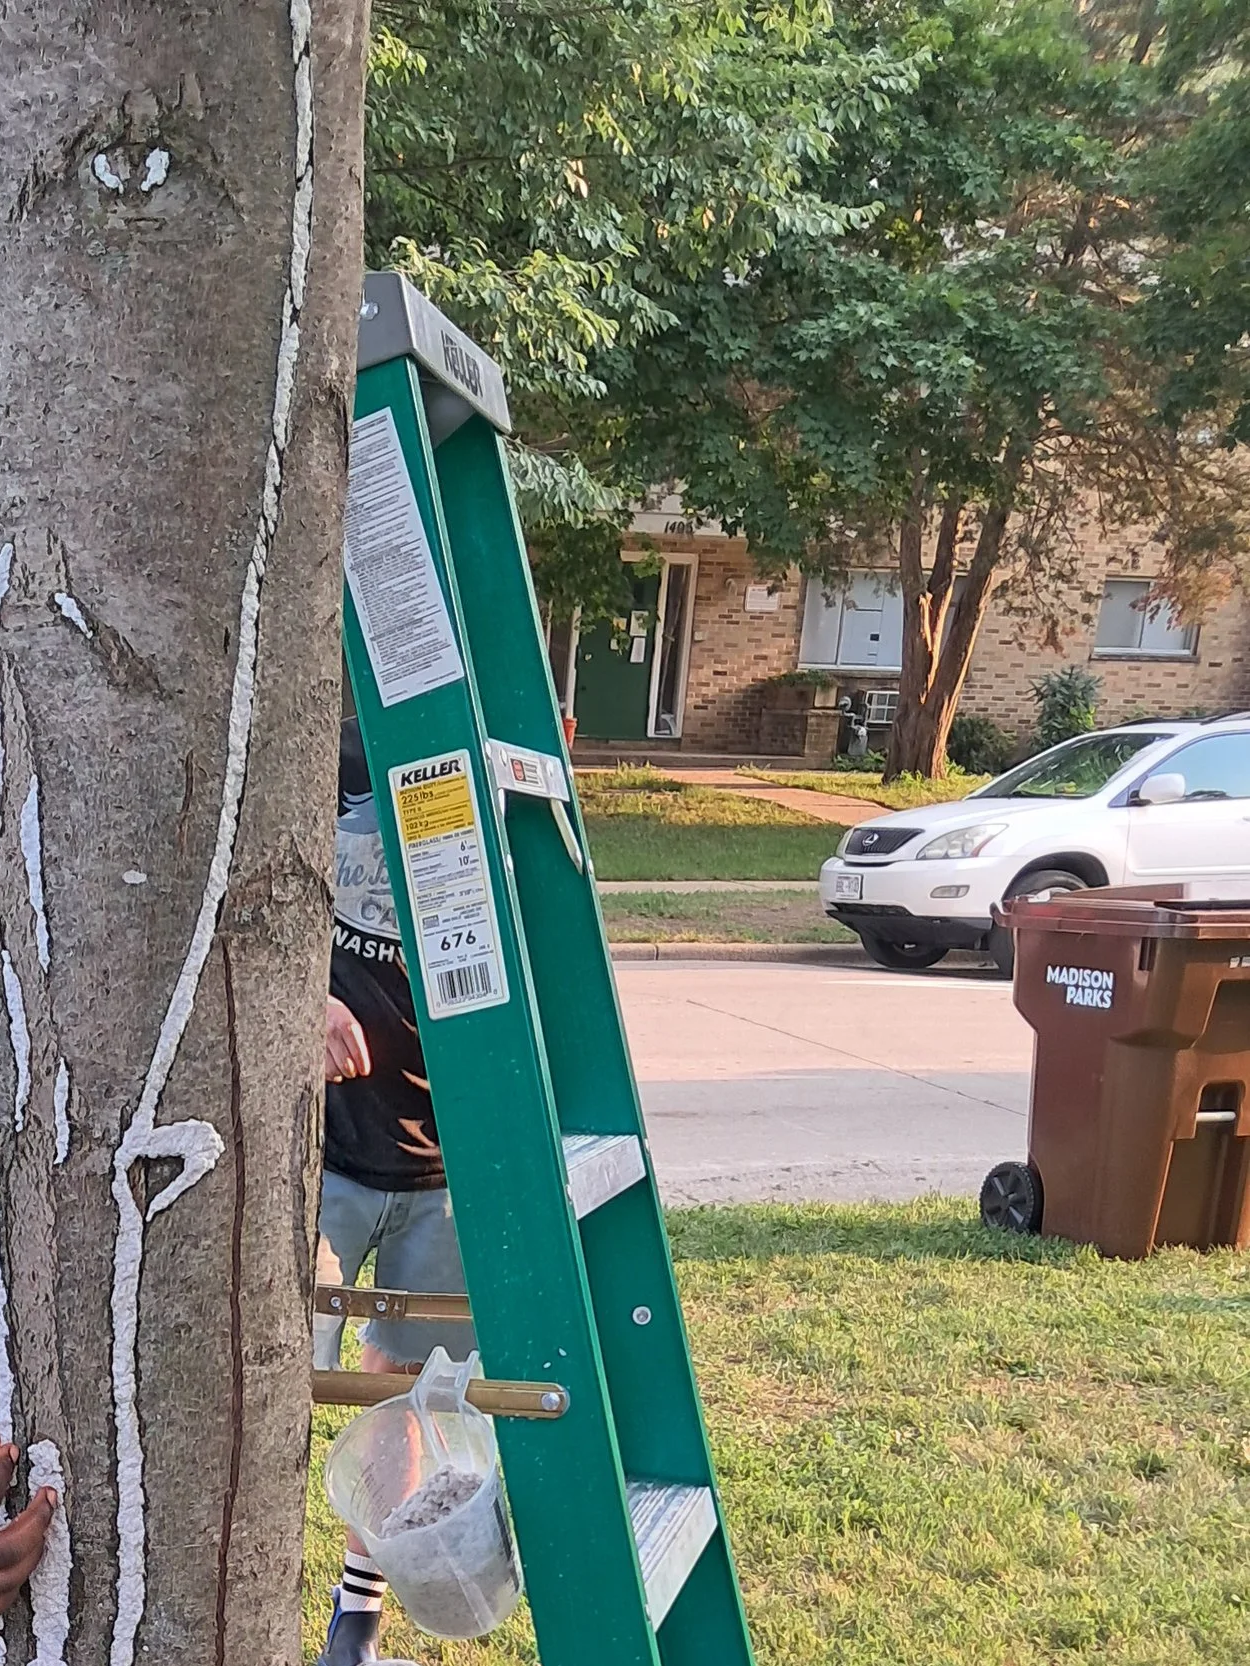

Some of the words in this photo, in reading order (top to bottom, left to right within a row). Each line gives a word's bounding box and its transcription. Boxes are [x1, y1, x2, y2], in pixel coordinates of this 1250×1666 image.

[440, 329, 484, 398] KELLER
[400, 758, 462, 788] KELLER
[440, 930, 477, 951] 676
[1046, 965, 1114, 990] MADISON
[1066, 987, 1112, 1009] PARKS
